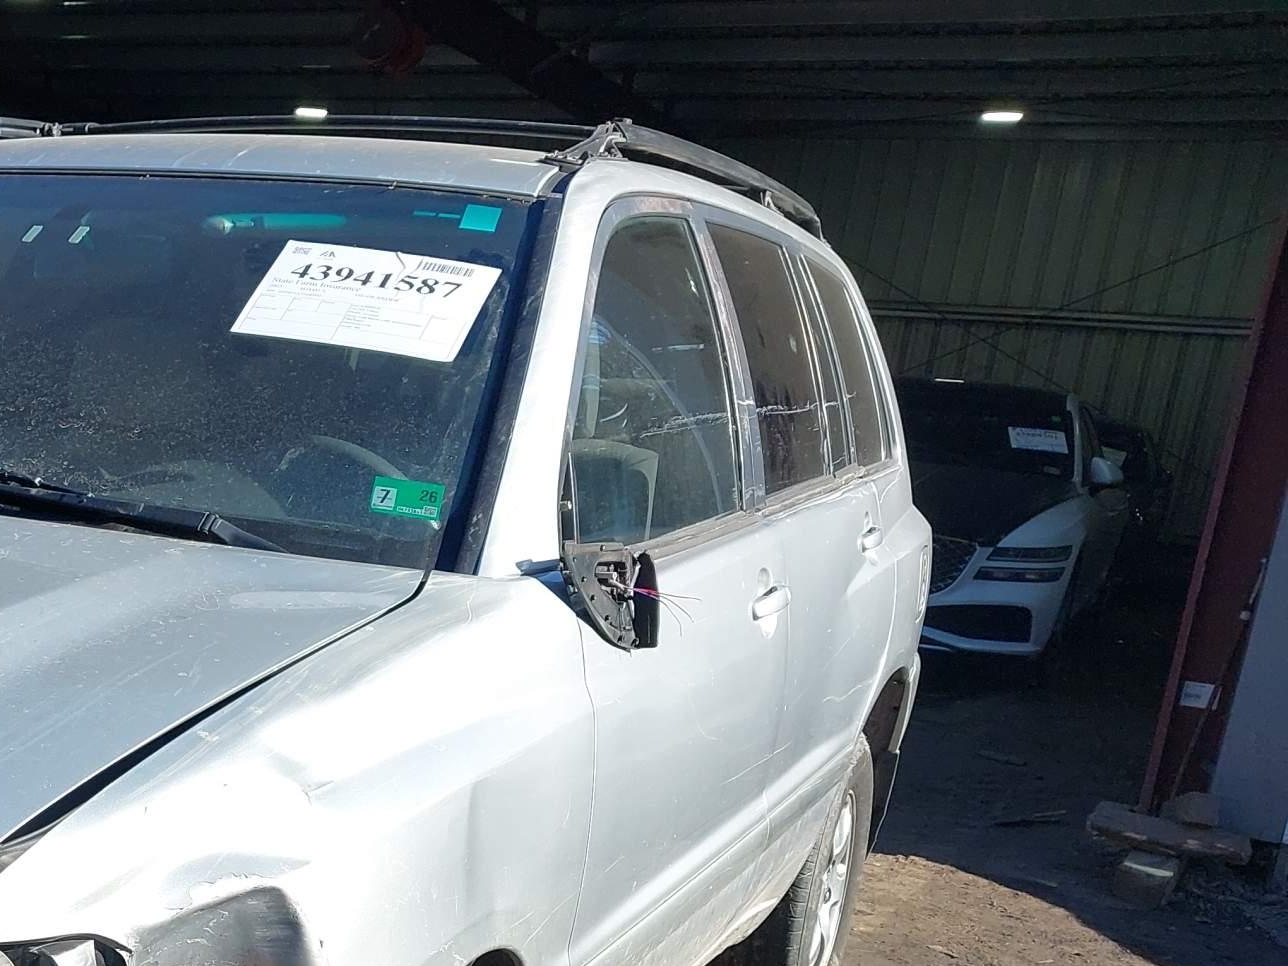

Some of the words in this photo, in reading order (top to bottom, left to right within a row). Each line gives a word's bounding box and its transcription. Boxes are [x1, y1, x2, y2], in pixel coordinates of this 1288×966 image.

[291, 263, 462, 298] 43941587
[379, 489, 391, 504] 7
[419, 489, 438, 504] 26
